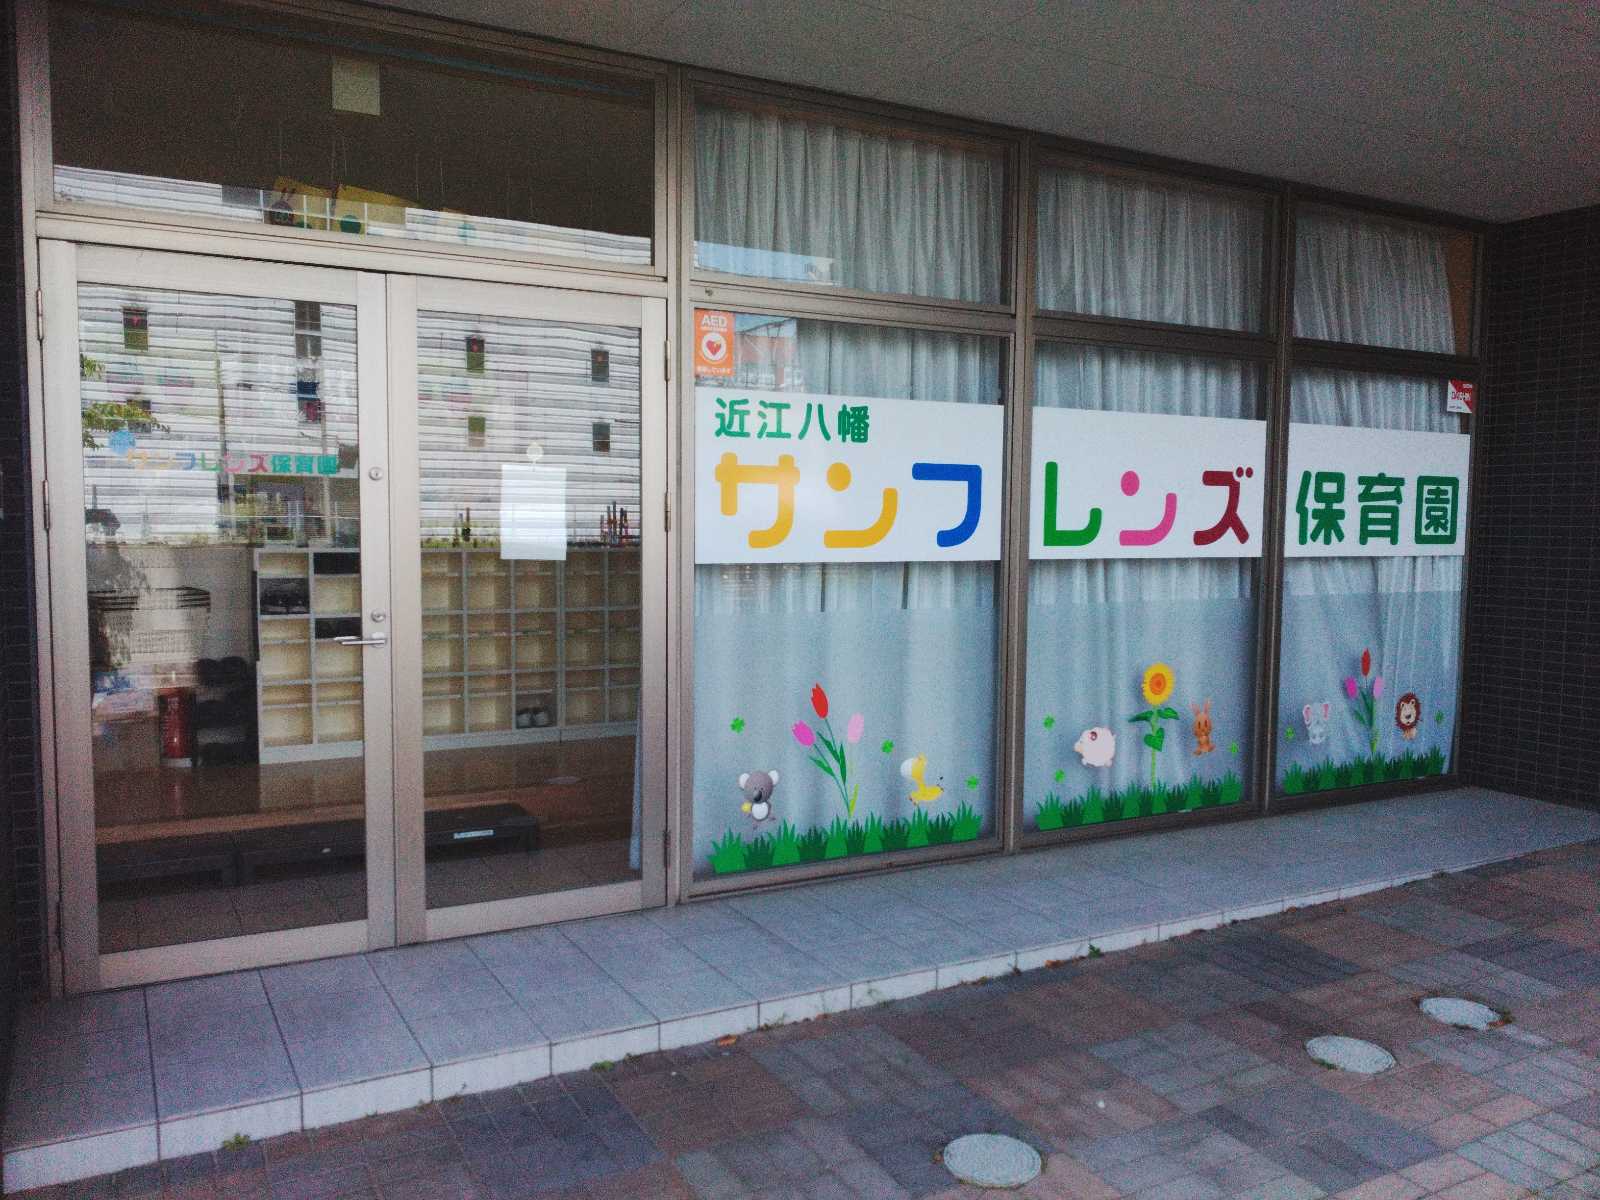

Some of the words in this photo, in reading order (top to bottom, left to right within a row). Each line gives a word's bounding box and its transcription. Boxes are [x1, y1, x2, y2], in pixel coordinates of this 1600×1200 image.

[701, 314, 728, 329] AED
[714, 397, 870, 443] 近江八幡
